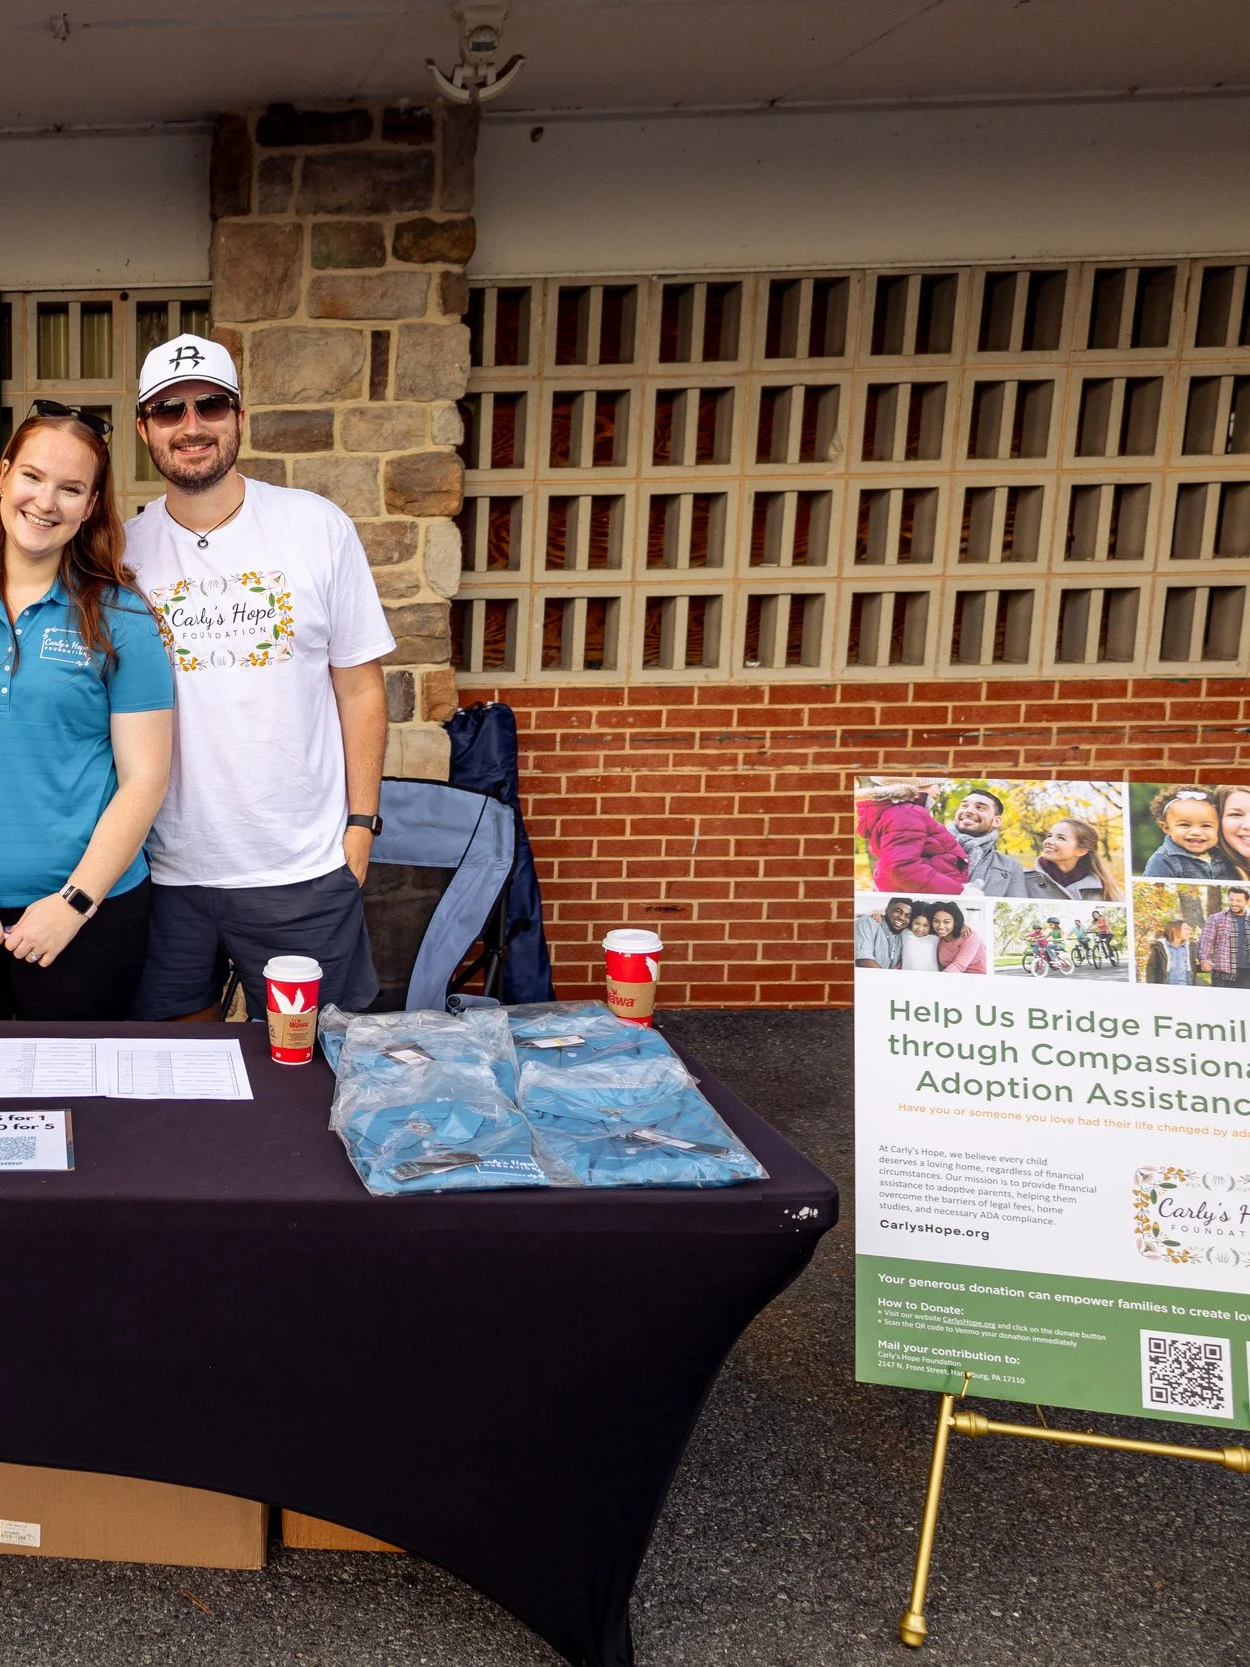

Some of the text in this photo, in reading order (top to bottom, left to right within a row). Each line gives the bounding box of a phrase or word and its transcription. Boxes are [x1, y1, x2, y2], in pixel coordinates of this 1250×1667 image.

[172, 602, 276, 630] Carly's Hope
[44, 638, 70, 649] Carly's
[182, 626, 266, 640] FOUNDATION
[44, 646, 88, 658] FOUNDATION
[890, 999, 1246, 1042] Help Us Bridge Famil
[888, 1034, 1250, 1079] through Compassion
[916, 1070, 1072, 1102] Adoption
[12, 1122, 41, 1130] for
[898, 1103, 926, 1112] Have
[930, 1107, 950, 1115] you
[968, 1109, 1022, 1120] someone
[1025, 1114, 1046, 1122] you
[1050, 1115, 1074, 1124] love
[1078, 1116, 1101, 1126] had
[1103, 1119, 1132, 1128] their
[1135, 1121, 1154, 1131] life
[1157, 1123, 1209, 1135] changed
[1213, 1127, 1228, 1138] by
[879, 1144, 888, 1152] At
[891, 1145, 919, 1156] Carly's
[921, 1148, 947, 1158] Hope,
[965, 1152, 996, 1161] believe
[999, 1156, 1024, 1165] every
[1026, 1157, 1047, 1166] child
[879, 1156, 917, 1166] deserves
[927, 1160, 953, 1170] loving
[956, 1162, 983, 1173] home,
[986, 1167, 1032, 1176] regardless
[1034, 1169, 1043, 1177] of
[1046, 1170, 1084, 1180] financial
[879, 1167, 942, 1179] circumstances.
[945, 1173, 962, 1181] Our
[964, 1176, 998, 1184] mission
[1000, 1178, 1008, 1186] is
[1022, 1181, 1056, 1190] provide
[1058, 1183, 1097, 1193] financial
[879, 1180, 923, 1189] assistance
[937, 1184, 975, 1194] adoptive
[978, 1189, 1014, 1199] parents,
[1017, 1191, 1050, 1202] helping
[1052, 1194, 1076, 1203] them
[1158, 1198, 1231, 1226] Carly's
[880, 1219, 989, 1240] CarlysHope.org
[1171, 1224, 1245, 1237] FOUNDAT
[878, 1273, 905, 1284] Your
[908, 1278, 965, 1291] generous
[969, 1283, 1024, 1297] donation
[1028, 1291, 1050, 1300] can
[1054, 1294, 1114, 1307] empower
[1118, 1298, 1168, 1313] families
[1171, 1305, 1185, 1314] to
[1189, 1308, 1231, 1320] create
[878, 1298, 964, 1315] How to Donate:
[884, 1309, 899, 1317] Visit
[914, 1314, 941, 1322] website
[942, 1316, 996, 1329] CarlysHope.org
[1012, 1324, 1028, 1332] click
[1054, 1329, 1080, 1338] donate
[1082, 1331, 1106, 1341] button
[954, 1327, 980, 1335] Venmo
[998, 1332, 1030, 1341] donation
[1032, 1336, 1077, 1348] immediately
[877, 1351, 961, 1367] Carly's Hope Foundation
[878, 1340, 1020, 1364] Mail your contribution to:
[906, 1363, 924, 1372] Front
[926, 1366, 949, 1375] Street,
[1003, 1376, 1025, 1384] 17110
